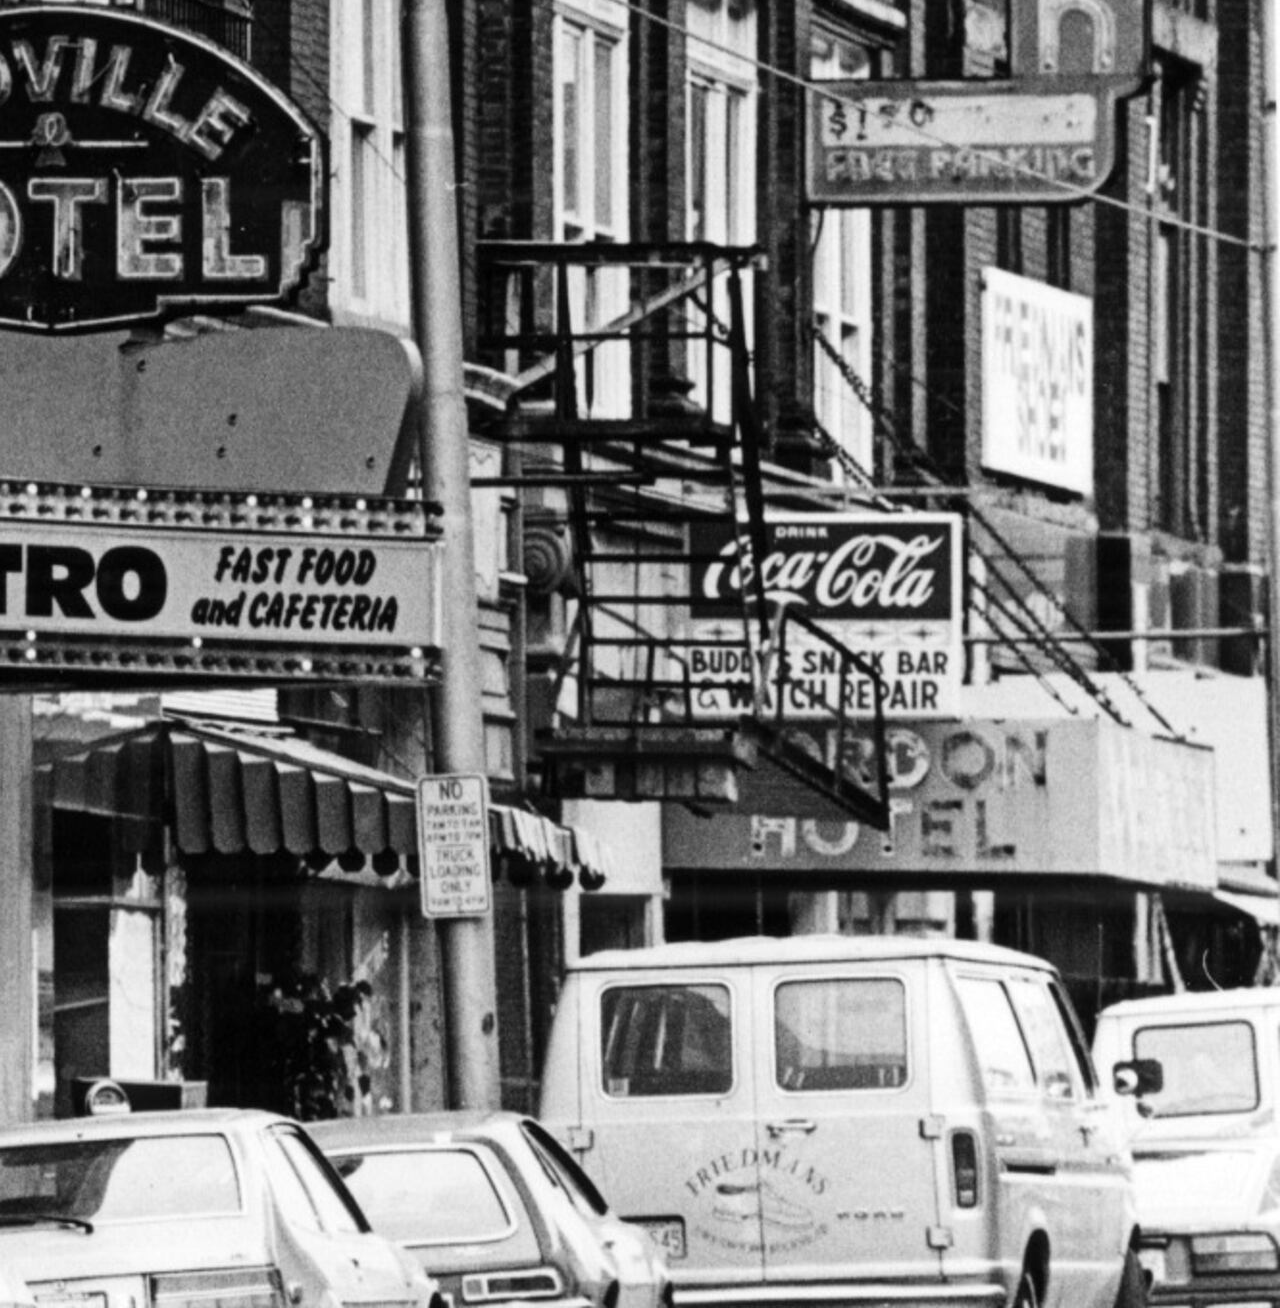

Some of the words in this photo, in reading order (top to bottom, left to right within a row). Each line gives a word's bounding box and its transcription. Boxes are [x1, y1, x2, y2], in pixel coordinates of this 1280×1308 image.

[775, 526, 828, 539] DRINK
[213, 544, 293, 584] FAST
[296, 547, 377, 587] FOOD
[702, 534, 945, 608] Coca-Cola
[190, 590, 248, 628] and
[248, 591, 399, 633] CAFETERIA
[692, 649, 790, 675] BUDDYS
[802, 649, 884, 675] SNCK
[897, 649, 949, 675] BAR
[727, 678, 827, 710] WACH
[842, 678, 939, 710] REPAIR
[439, 780, 463, 801] NO
[426, 801, 479, 817] PARKING
[436, 848, 475, 863] TRUCK
[428, 862, 481, 880] LOADING
